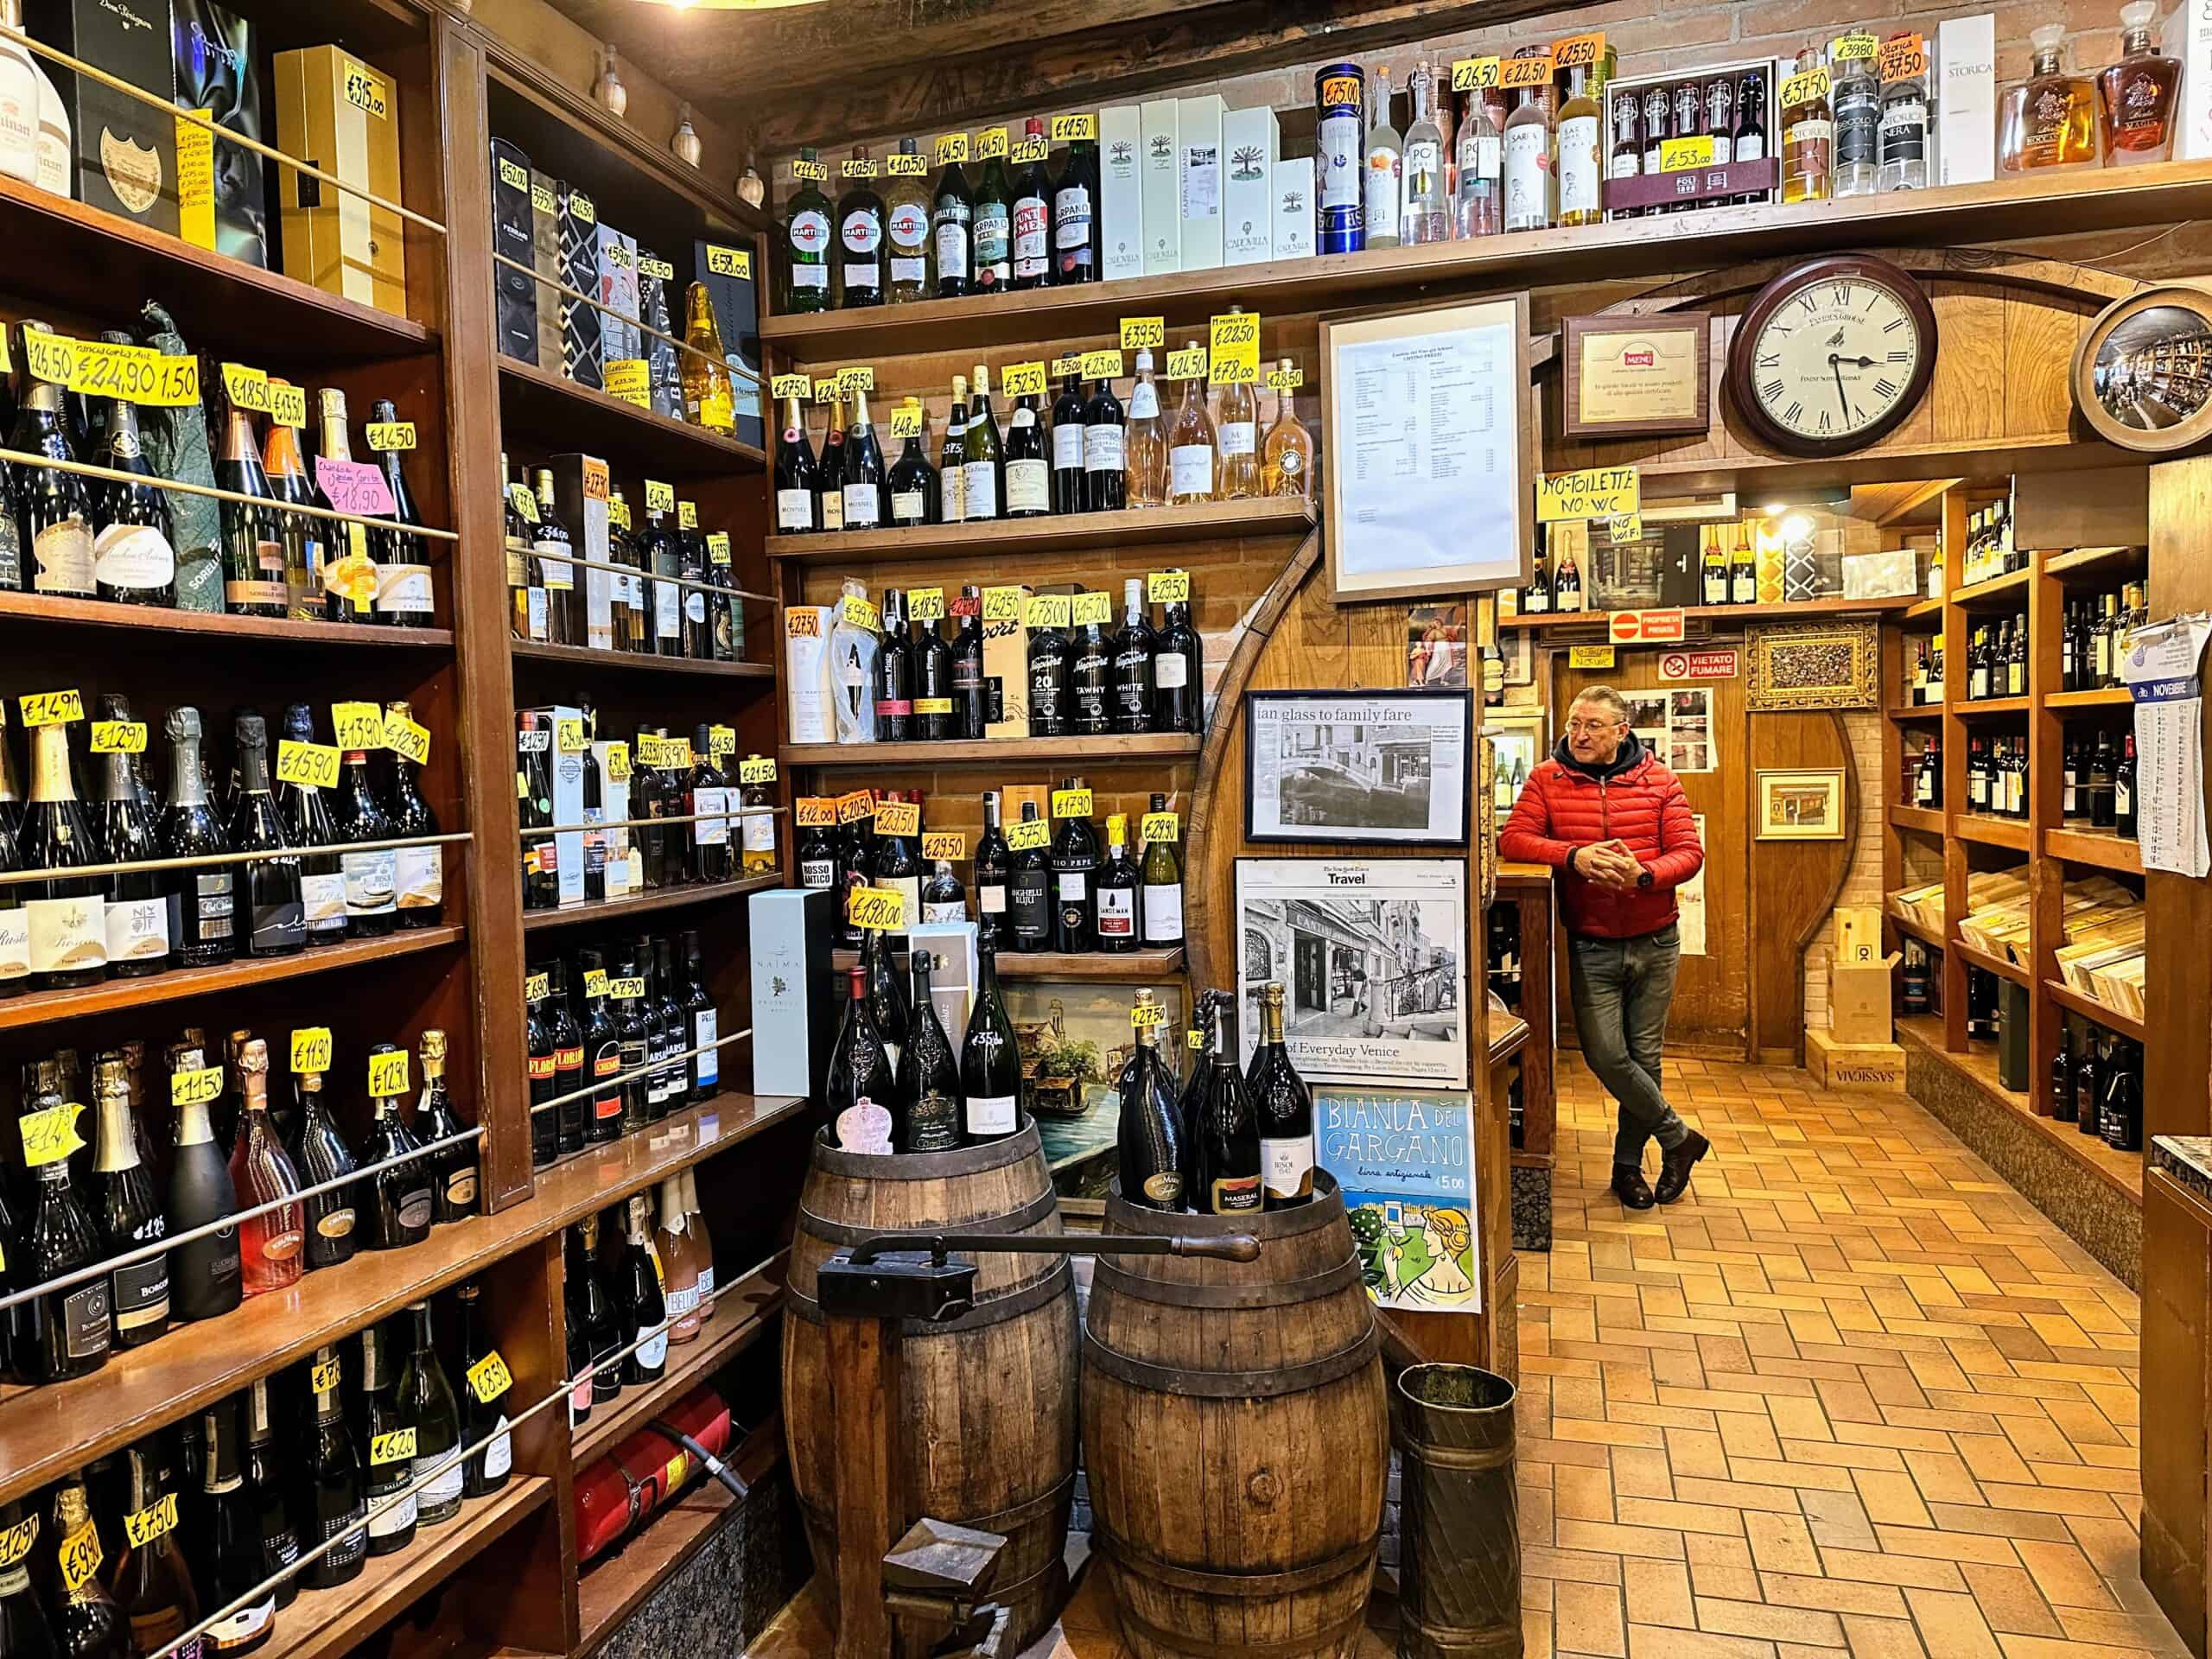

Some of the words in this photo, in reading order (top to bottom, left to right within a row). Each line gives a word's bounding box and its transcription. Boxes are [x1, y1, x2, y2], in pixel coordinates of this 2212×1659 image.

[1948, 63, 1993, 79] STORICA
[1885, 125, 1911, 139] NERA
[891, 222, 925, 231] MARTINI
[1625, 356, 1653, 365] MENU
[1691, 656, 1733, 665] VIETATO
[1690, 665, 1734, 676] FUMARE
[1035, 676, 1052, 689] 20
[1116, 683, 1145, 693] WHITE
[1257, 708, 1278, 720] ian
[1281, 706, 1317, 723] glass
[1319, 709, 1333, 721] to
[1334, 707, 1382, 724] family
[1382, 708, 1413, 721] fare
[1070, 858, 1092, 868] PEPE
[1328, 873, 1366, 886] Travel
[1287, 1042, 1300, 1054] of
[1300, 1042, 1357, 1058] Everyday
[1360, 1044, 1400, 1058] Venice
[1835, 1070, 1895, 1083] SASSICAIA
[1325, 1096, 1429, 1132] BIANCA
[1325, 1131, 1465, 1167] GARGANO
